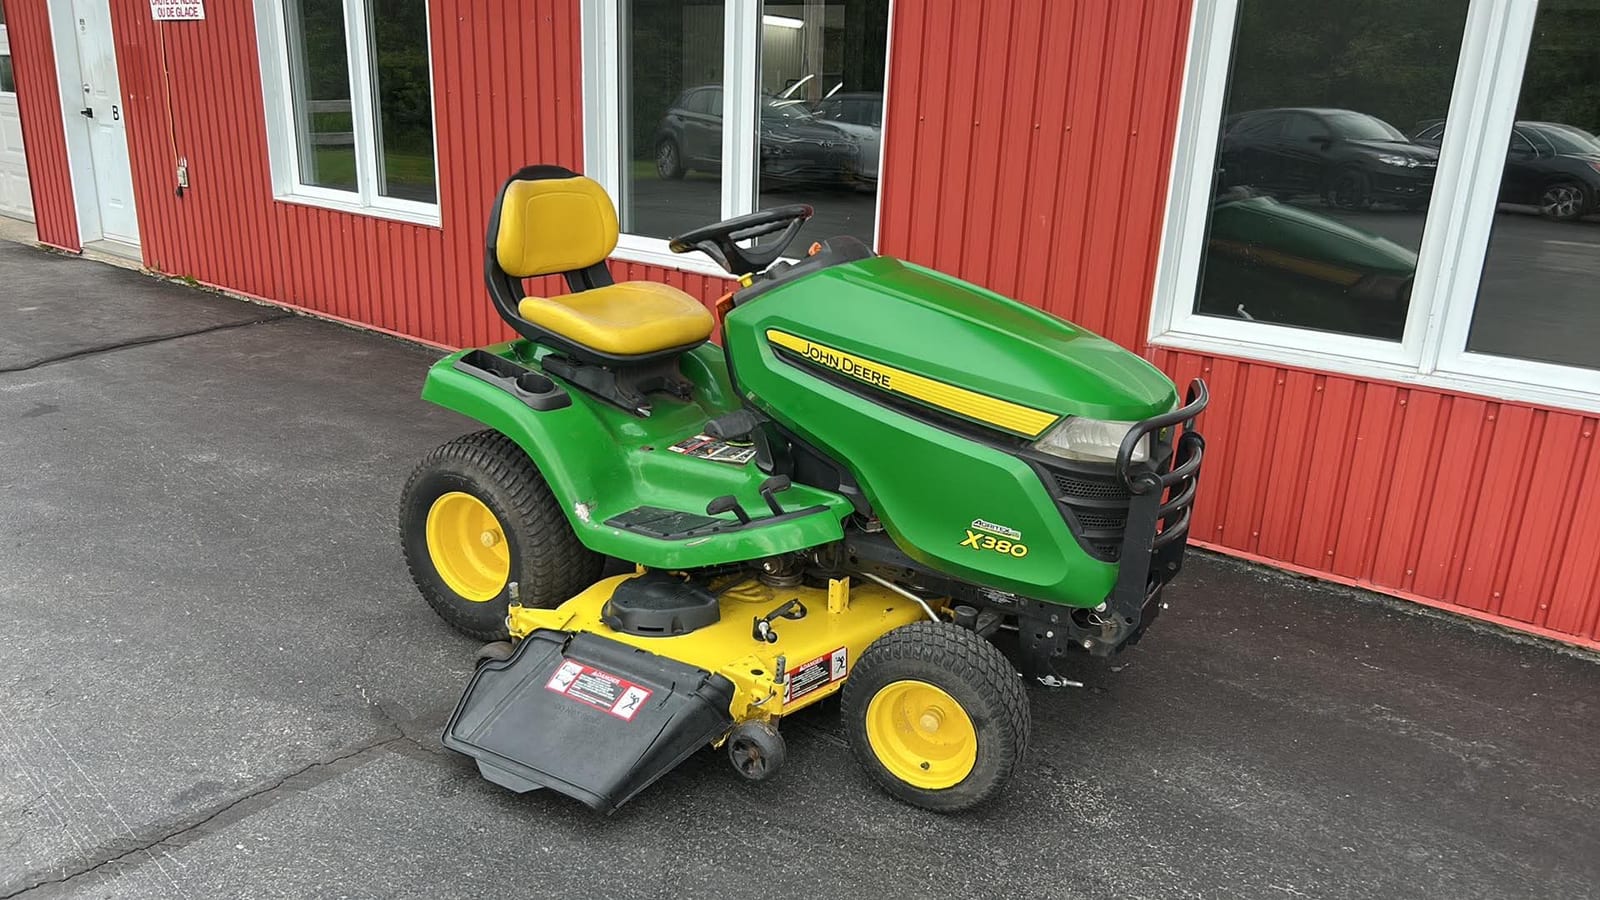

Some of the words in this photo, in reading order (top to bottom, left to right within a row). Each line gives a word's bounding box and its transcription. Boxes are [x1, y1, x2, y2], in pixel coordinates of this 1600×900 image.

[157, 7, 165, 17] OU
[166, 7, 175, 17] DE
[176, 7, 199, 17] GLACE
[112, 105, 120, 120] B
[802, 343, 839, 367] JOHN
[842, 357, 891, 387] DEERE
[959, 529, 1028, 557] X380
